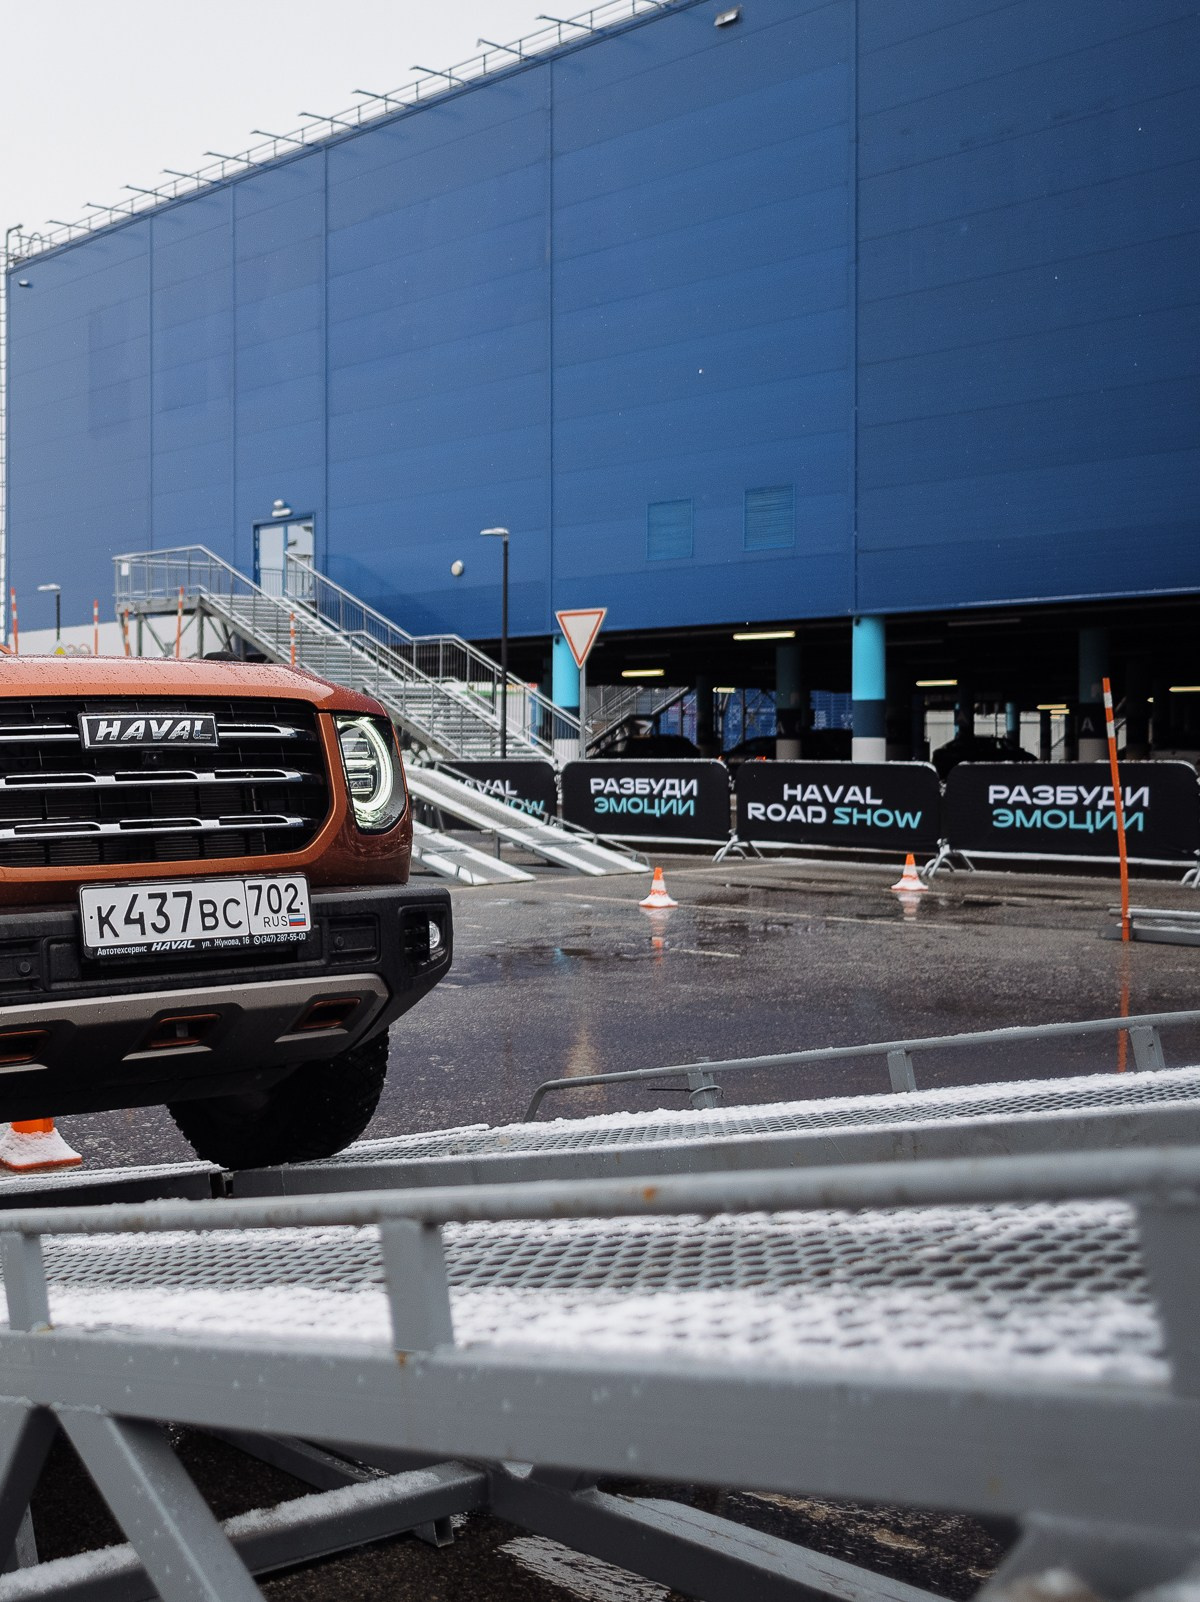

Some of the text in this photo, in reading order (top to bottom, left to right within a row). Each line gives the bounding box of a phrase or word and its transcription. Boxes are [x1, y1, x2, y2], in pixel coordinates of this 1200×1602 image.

[95, 720, 212, 740] HAVAL
[590, 777, 697, 798] РАЗБУДИ
[783, 783, 883, 805] HAVAL
[988, 785, 1149, 810] РАЗБУДИ
[594, 797, 695, 817] ЭМОЦИИ
[747, 802, 922, 829] ROAD SHOW
[992, 808, 1144, 833] ЭМОЦИИ
[247, 883, 301, 916] 702
[264, 915, 288, 928] RUS
[97, 932, 306, 956] Автотехсервис HAVAL ул. Жукова, 16 (347) 287-55-00
